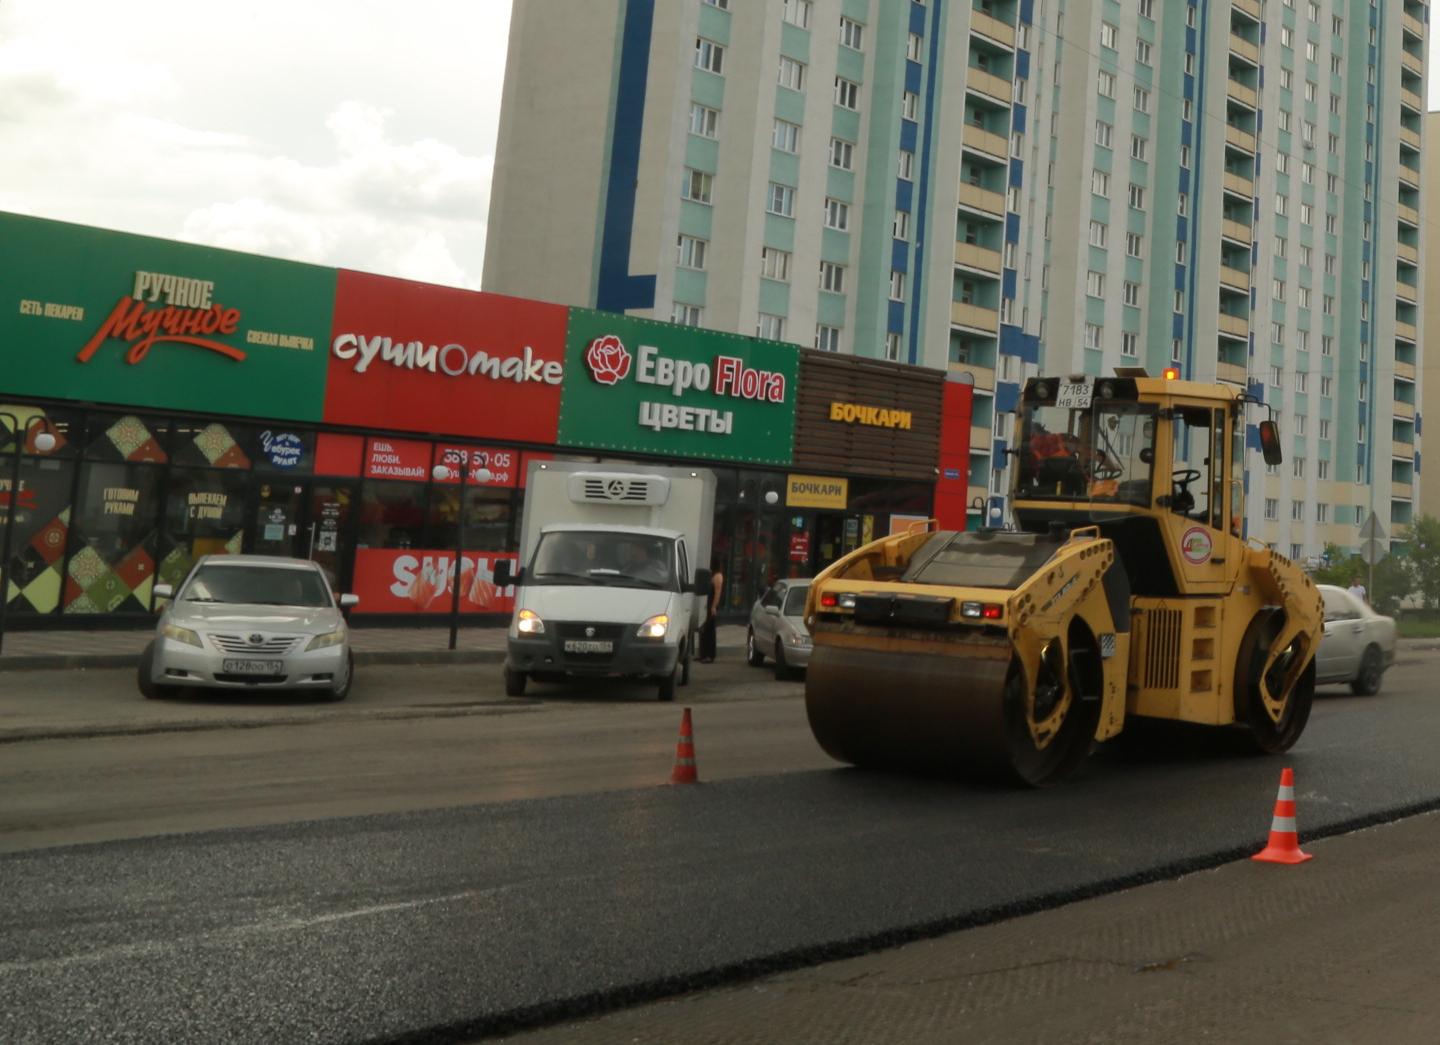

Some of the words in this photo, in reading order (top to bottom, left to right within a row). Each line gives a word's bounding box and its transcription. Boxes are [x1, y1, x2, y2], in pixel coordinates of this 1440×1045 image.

[133, 270, 214, 310] РУЧНОЕ
[20, 299, 43, 316] СЕТЬ
[77, 295, 247, 366] Мучное
[247, 329, 279, 347] СВЕЖАЯ
[279, 333, 315, 350] ВЫПЕЧКА
[635, 344, 710, 396] Евро
[714, 354, 785, 403] Flora
[1063, 384, 1089, 396] 7183
[1077, 399, 1088, 407] 54
[639, 400, 733, 434] ЦВЕТЫ
[829, 402, 912, 430] БОЧКАРИ
[371, 465, 425, 477] ЗАКАЗЫВАЙ!
[791, 481, 842, 497] БОЧКАРИ
[104, 502, 135, 516] РУКАМИ
[190, 506, 196, 518] С
